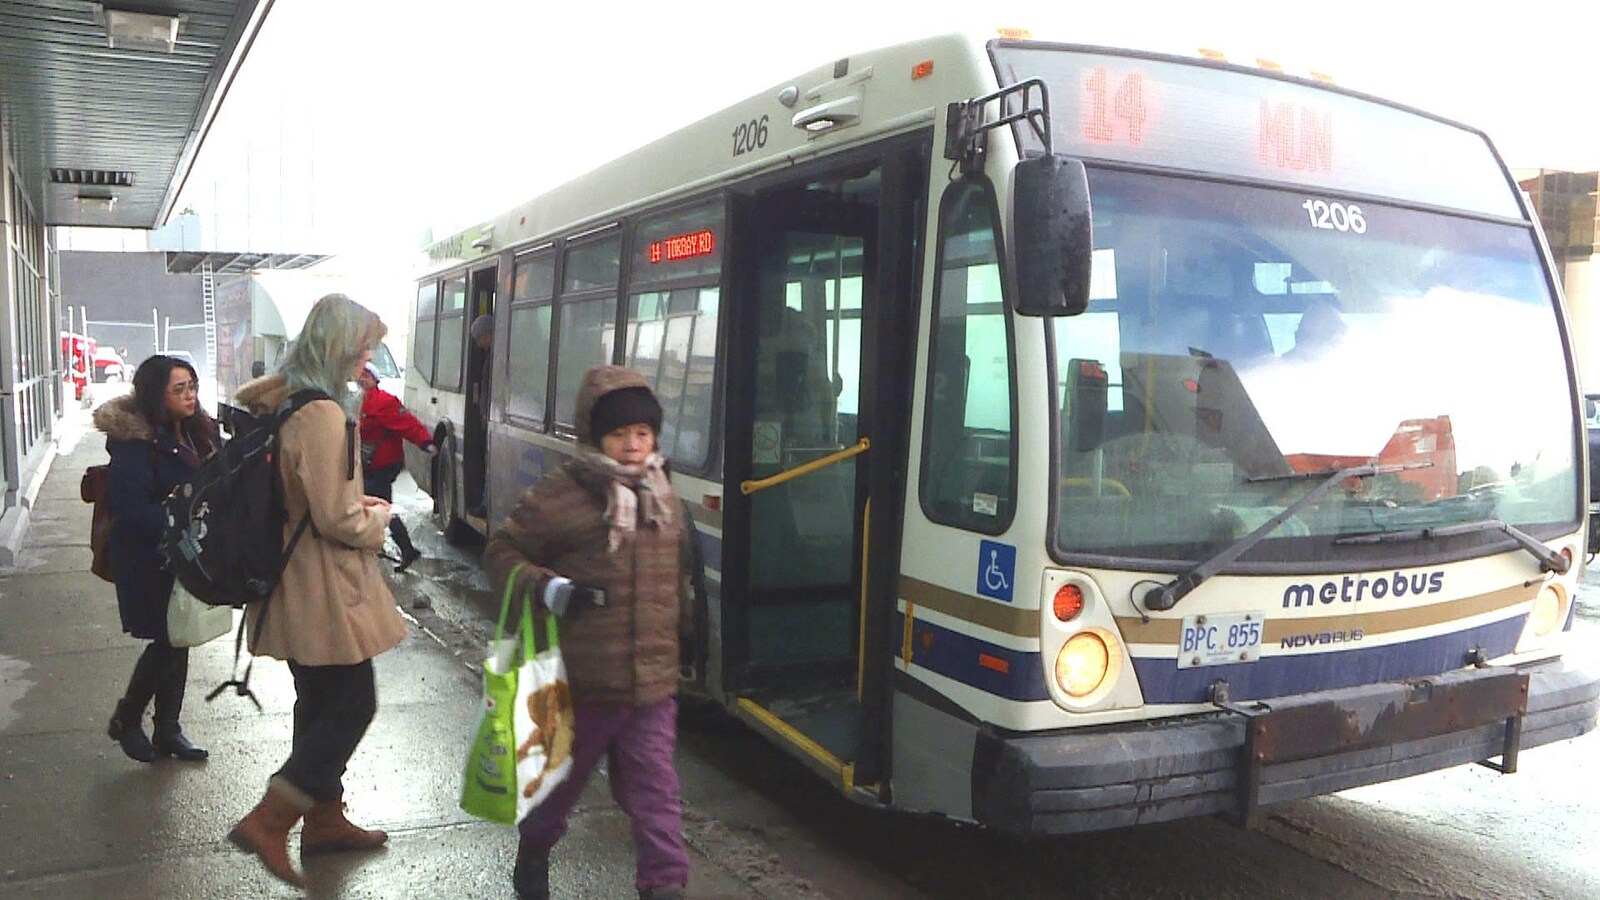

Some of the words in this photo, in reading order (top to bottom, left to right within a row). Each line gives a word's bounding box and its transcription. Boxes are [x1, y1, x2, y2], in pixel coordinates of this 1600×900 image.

[732, 114, 769, 156] 1206
[1084, 66, 1146, 145] 14
[1259, 99, 1332, 174] MUN
[1303, 199, 1367, 234] 1206
[665, 233, 698, 259] TORBAY
[699, 231, 712, 253] RD
[1282, 571, 1444, 608] metrobus
[1183, 626, 1217, 652] BPC
[1227, 622, 1259, 648] 855
